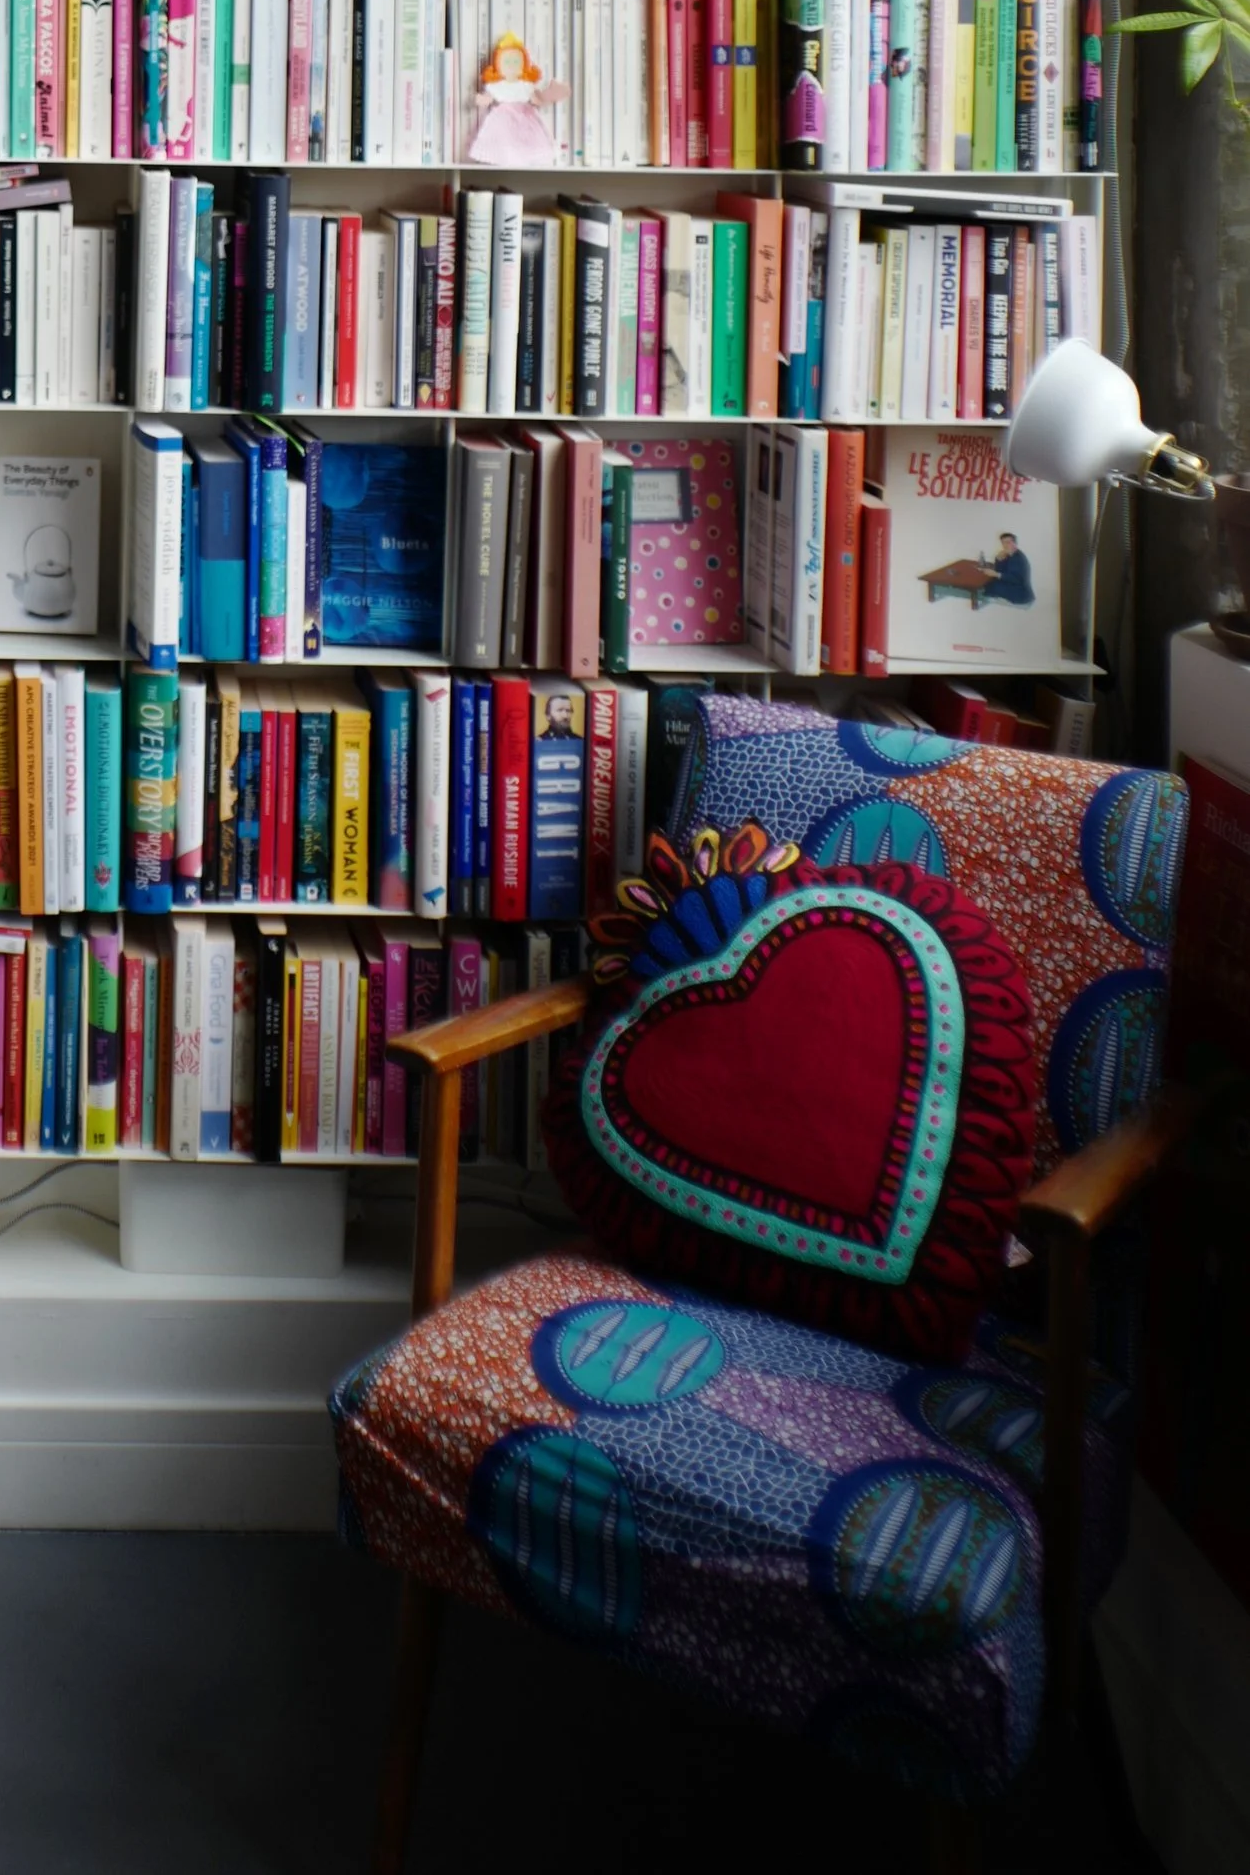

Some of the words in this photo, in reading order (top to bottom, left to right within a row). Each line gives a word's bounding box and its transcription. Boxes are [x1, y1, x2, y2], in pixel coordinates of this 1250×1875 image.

[39, 22, 53, 76] PASCOE
[437, 220, 456, 274] NIMKO
[437, 277, 454, 304] ALI
[585, 258, 605, 300] PERIODS
[939, 235, 957, 329] MEMORIAL
[584, 305, 603, 334] GONE
[992, 294, 1007, 334] KEEPING
[584, 338, 601, 376] PUBLIC
[992, 337, 1007, 354] THE
[991, 356, 1007, 390] HOUSE
[937, 433, 994, 446] TANIGUCHI
[3, 463, 22, 474] The
[23, 464, 57, 477] Beauty
[58, 464, 70, 475] of
[3, 475, 47, 488] Everyday
[49, 476, 80, 489] Things
[844, 445, 857, 487] KAZUO
[908, 452, 930, 475] LE
[937, 455, 1042, 484] GOUR
[917, 475, 1024, 504] SOLITAIRE
[842, 490, 855, 547] ISHIGURO
[380, 537, 430, 551] Bluets
[615, 557, 627, 599] TOKYO
[323, 594, 374, 607] MAGGIE
[25, 685, 35, 705] APG
[25, 707, 35, 749] CREATIVE
[594, 693, 612, 741] PAIN
[26, 751, 36, 799] STRATEGY
[64, 705, 78, 817] EMOTIONAL
[137, 704, 166, 829] OVERSTORY
[342, 752, 361, 800] FIRST
[502, 775, 520, 829] SALMAN
[536, 754, 581, 861] GRANT
[593, 747, 611, 836] PREJUDICE
[27, 801, 37, 843] AWARDS
[28, 846, 37, 867] 2021
[146, 830, 161, 883] RICHARD
[342, 807, 359, 882] WOMAN
[503, 834, 519, 889] RUSHDIE
[134, 842, 151, 890] POWERS
